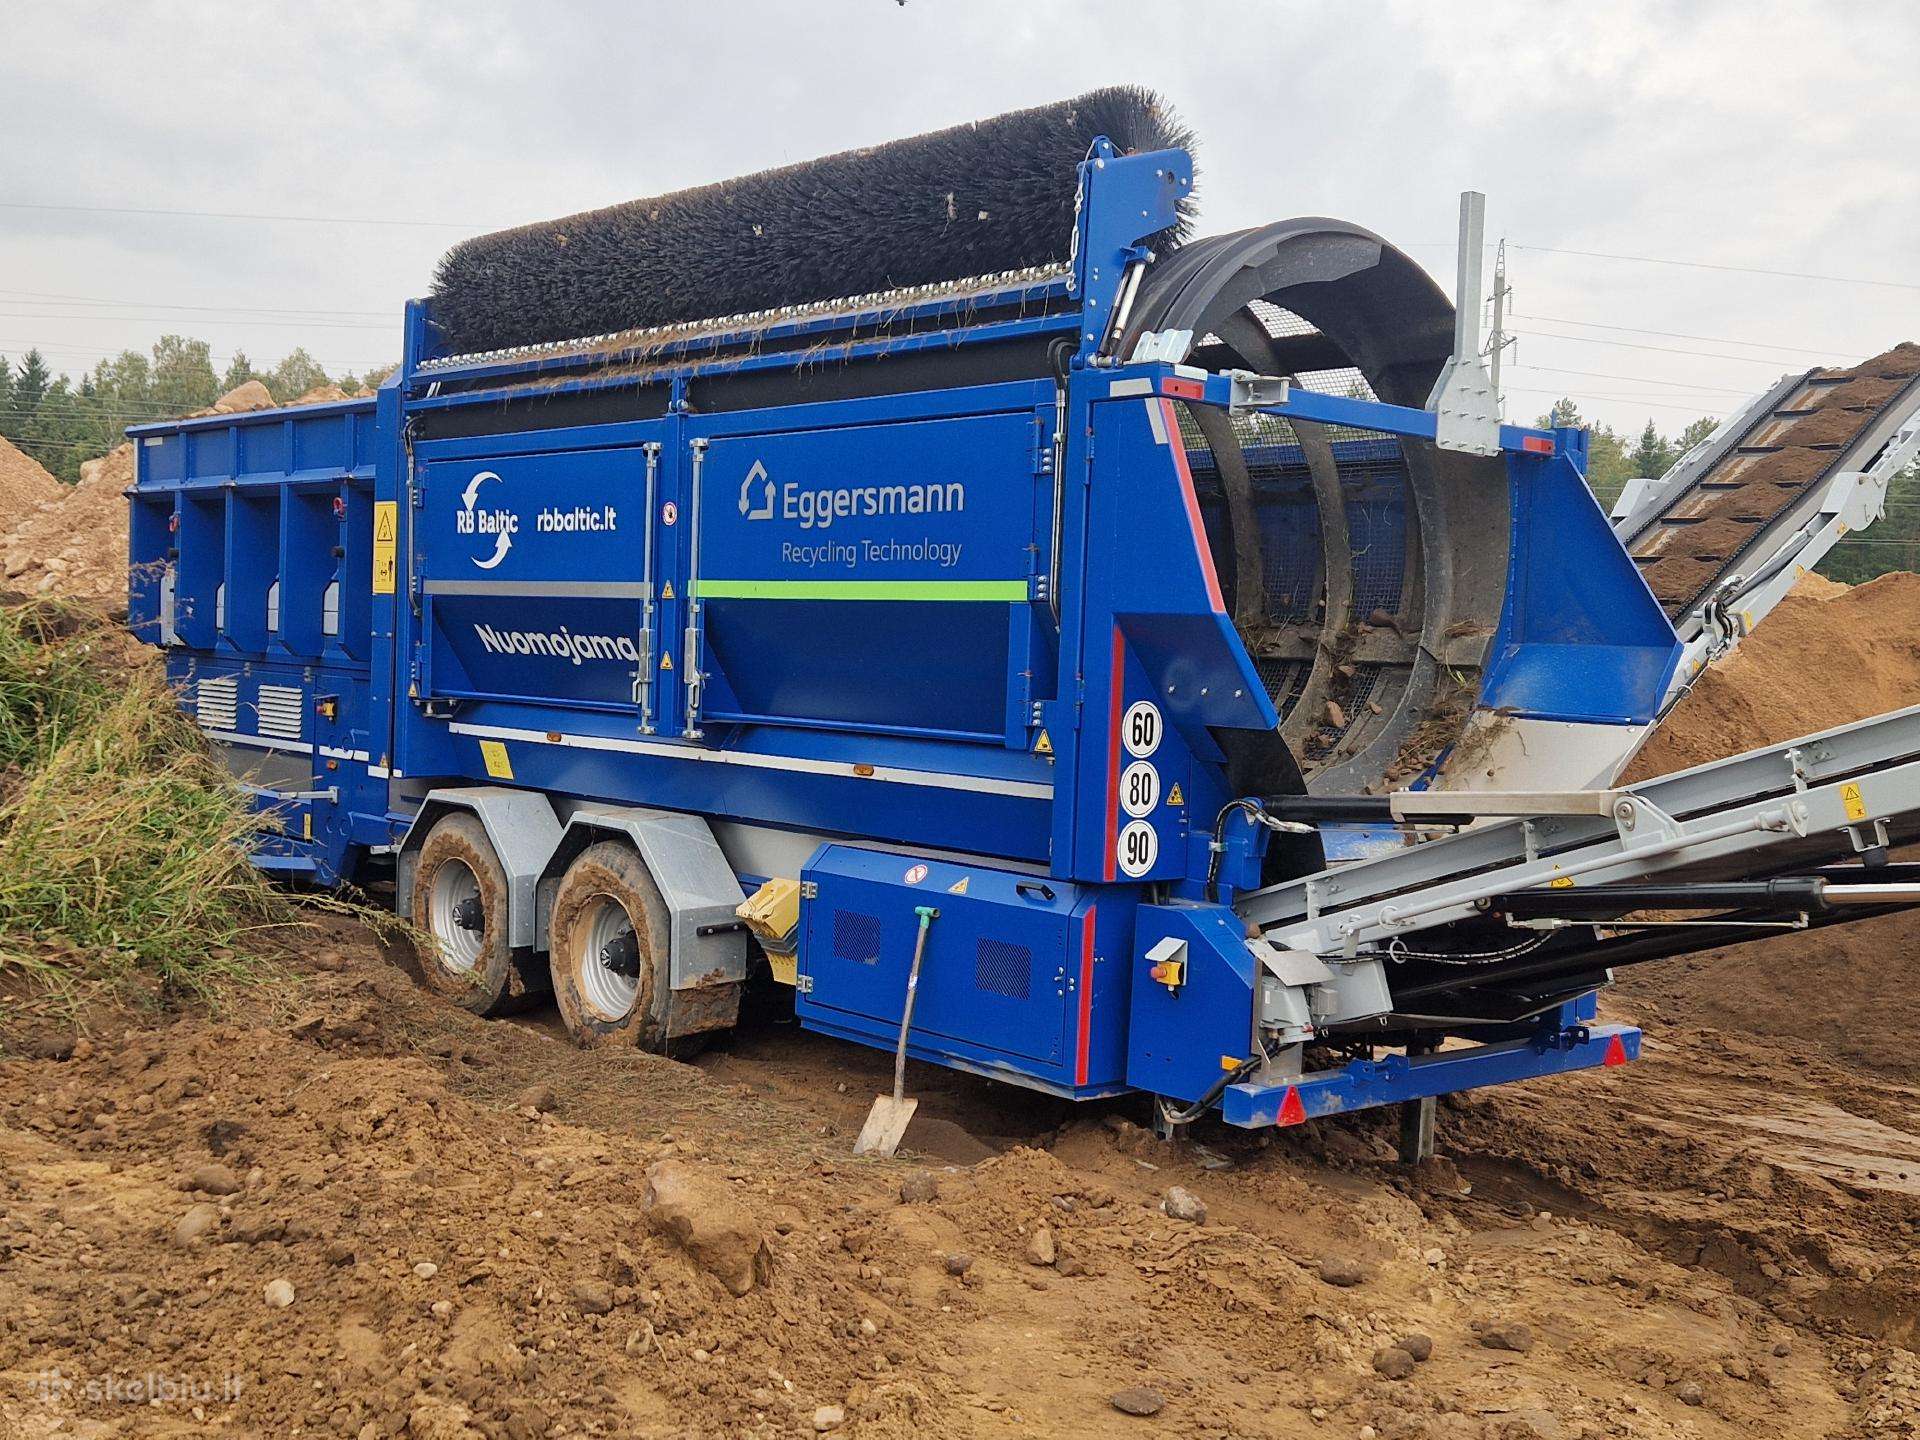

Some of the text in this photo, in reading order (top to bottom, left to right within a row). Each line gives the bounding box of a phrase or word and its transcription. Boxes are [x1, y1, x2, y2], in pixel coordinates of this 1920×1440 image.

[456, 509, 519, 534] RB Baltic
[537, 505, 617, 532] rbbaltic.lt
[783, 482, 964, 529] Eggersmann
[782, 537, 963, 568] Recycling Technology
[473, 623, 639, 665] Nuomojama
[1132, 712, 1154, 747] 60
[1129, 772, 1152, 806] 80
[1127, 831, 1149, 866] 90
